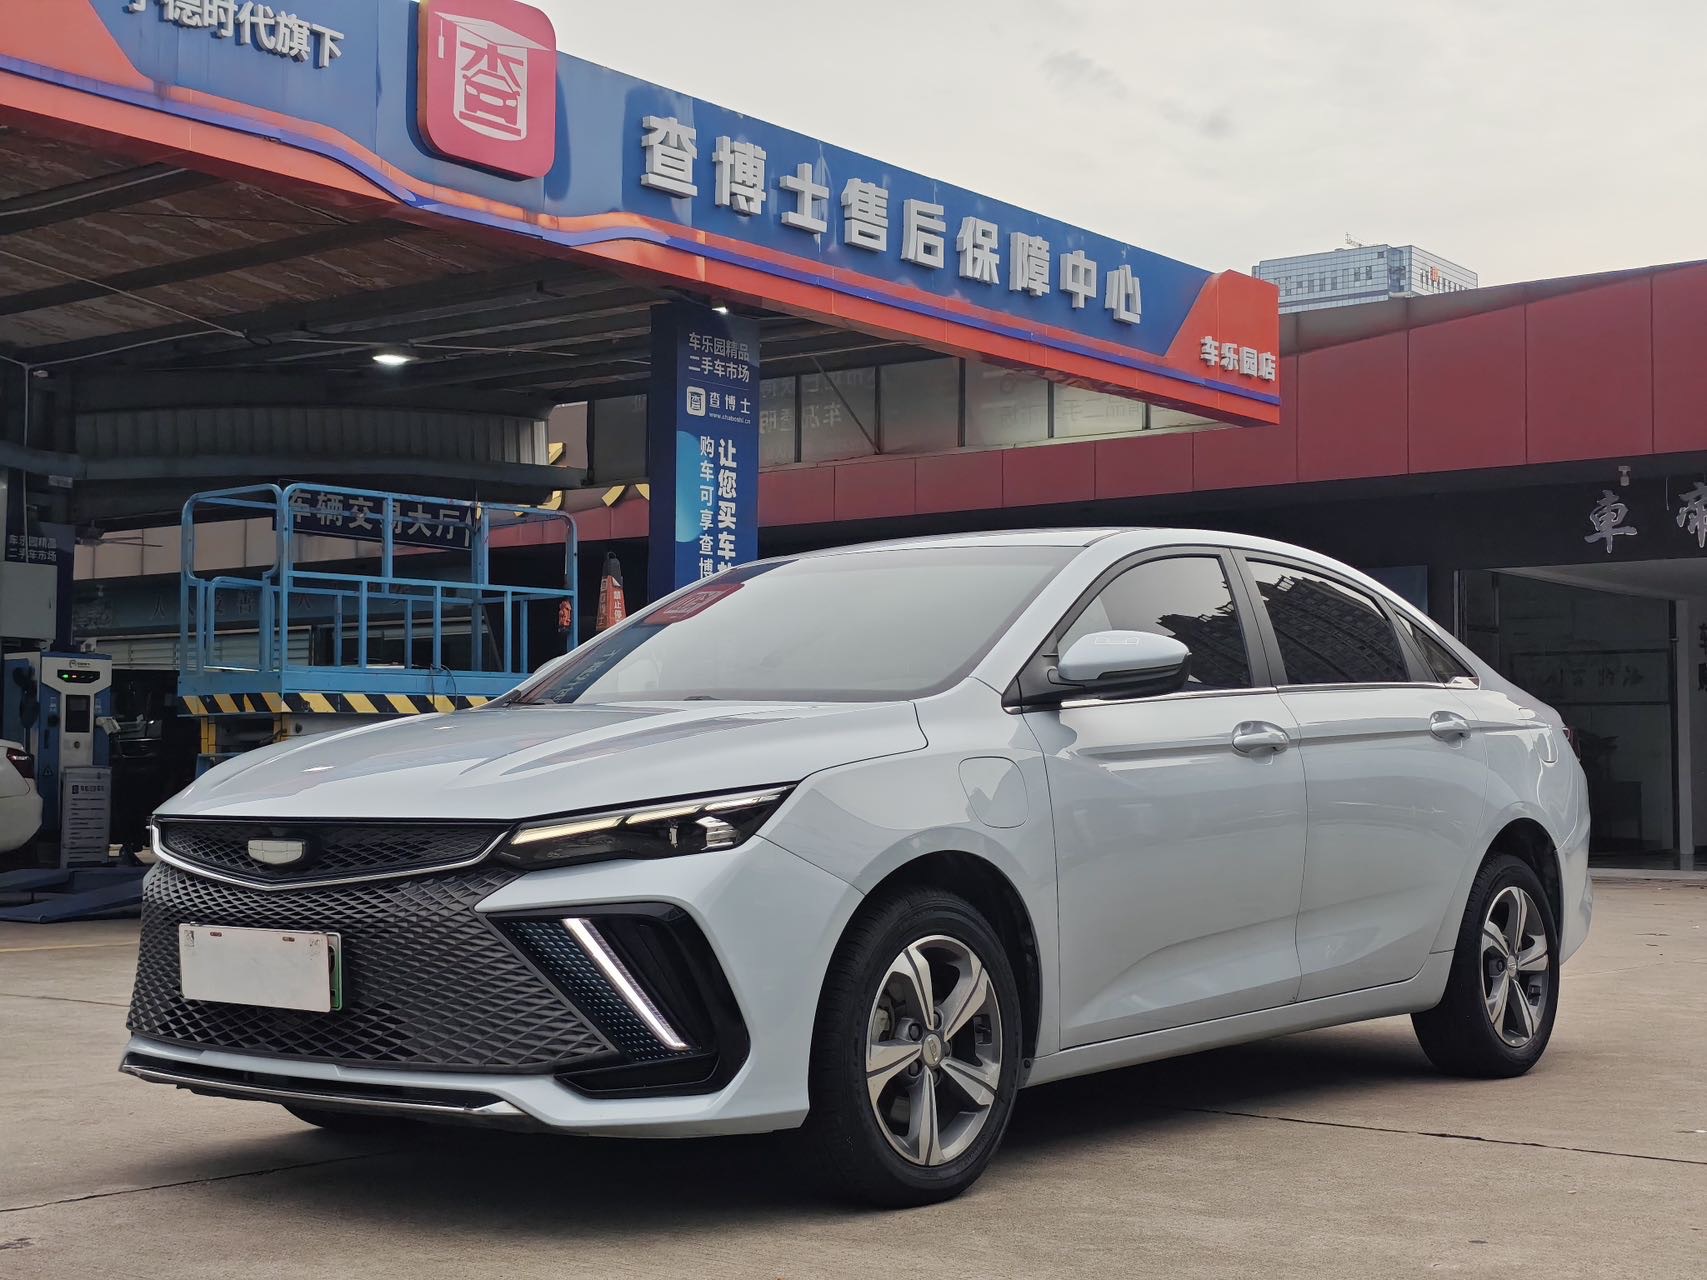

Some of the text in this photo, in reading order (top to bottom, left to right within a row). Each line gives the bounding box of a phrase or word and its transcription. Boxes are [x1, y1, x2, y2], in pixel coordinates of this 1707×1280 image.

[128, 0, 345, 68] 德时代旗下
[640, 115, 1142, 324] 查博士售后保障中心
[688, 331, 750, 362] 车乐园精品
[1200, 335, 1276, 382] 车乐园店
[688, 355, 750, 383] 二手车市场
[708, 411, 751, 425] www.chaboshi.cn
[709, 392, 751, 414] 查博士
